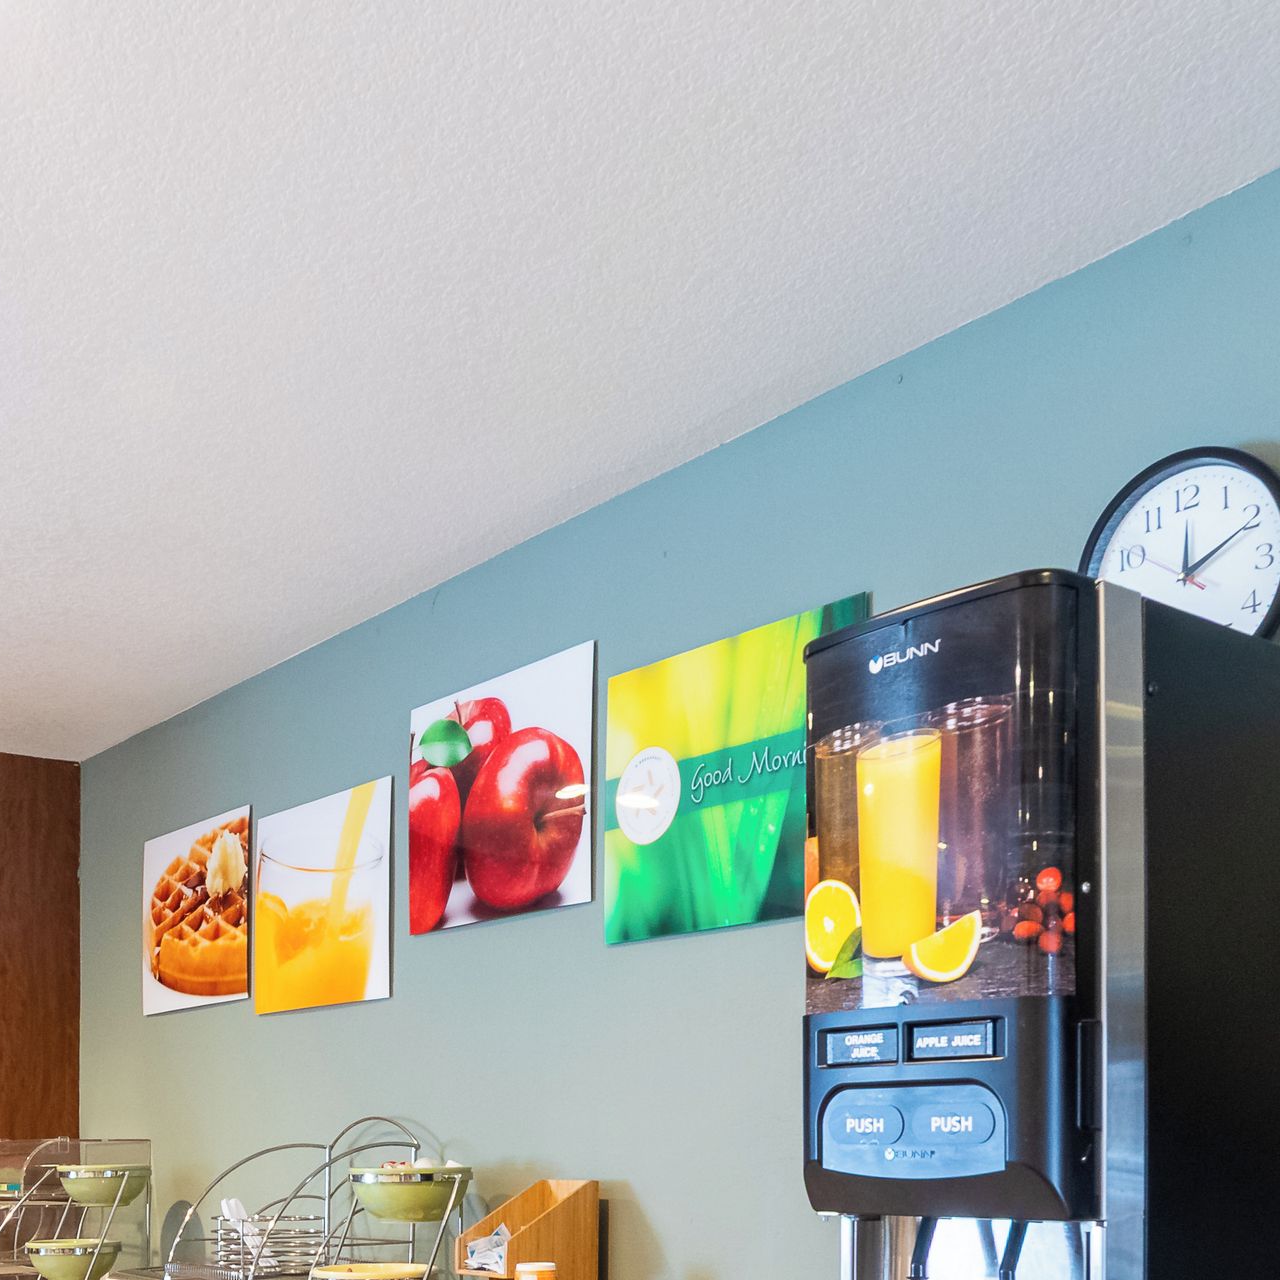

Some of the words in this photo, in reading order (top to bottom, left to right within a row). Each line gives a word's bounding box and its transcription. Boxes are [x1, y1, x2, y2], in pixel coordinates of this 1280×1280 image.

[1175, 484, 1201, 513] 12
[1223, 485, 1229, 510] 1
[1145, 506, 1162, 533] 11
[1242, 503, 1261, 531] 2
[1120, 544, 1146, 572] 10
[1254, 542, 1274, 570] 3
[1240, 588, 1262, 614] 4
[883, 638, 941, 668] BUNN
[690, 756, 734, 803] Good
[737, 740, 807, 784] Morni
[844, 1032, 884, 1046] ORANGE
[851, 1046, 879, 1058] JUICE
[916, 1036, 949, 1049] APPLE
[951, 1034, 982, 1047] JUICE
[845, 1117, 884, 1133] PUSH
[930, 1115, 973, 1133] PUSH
